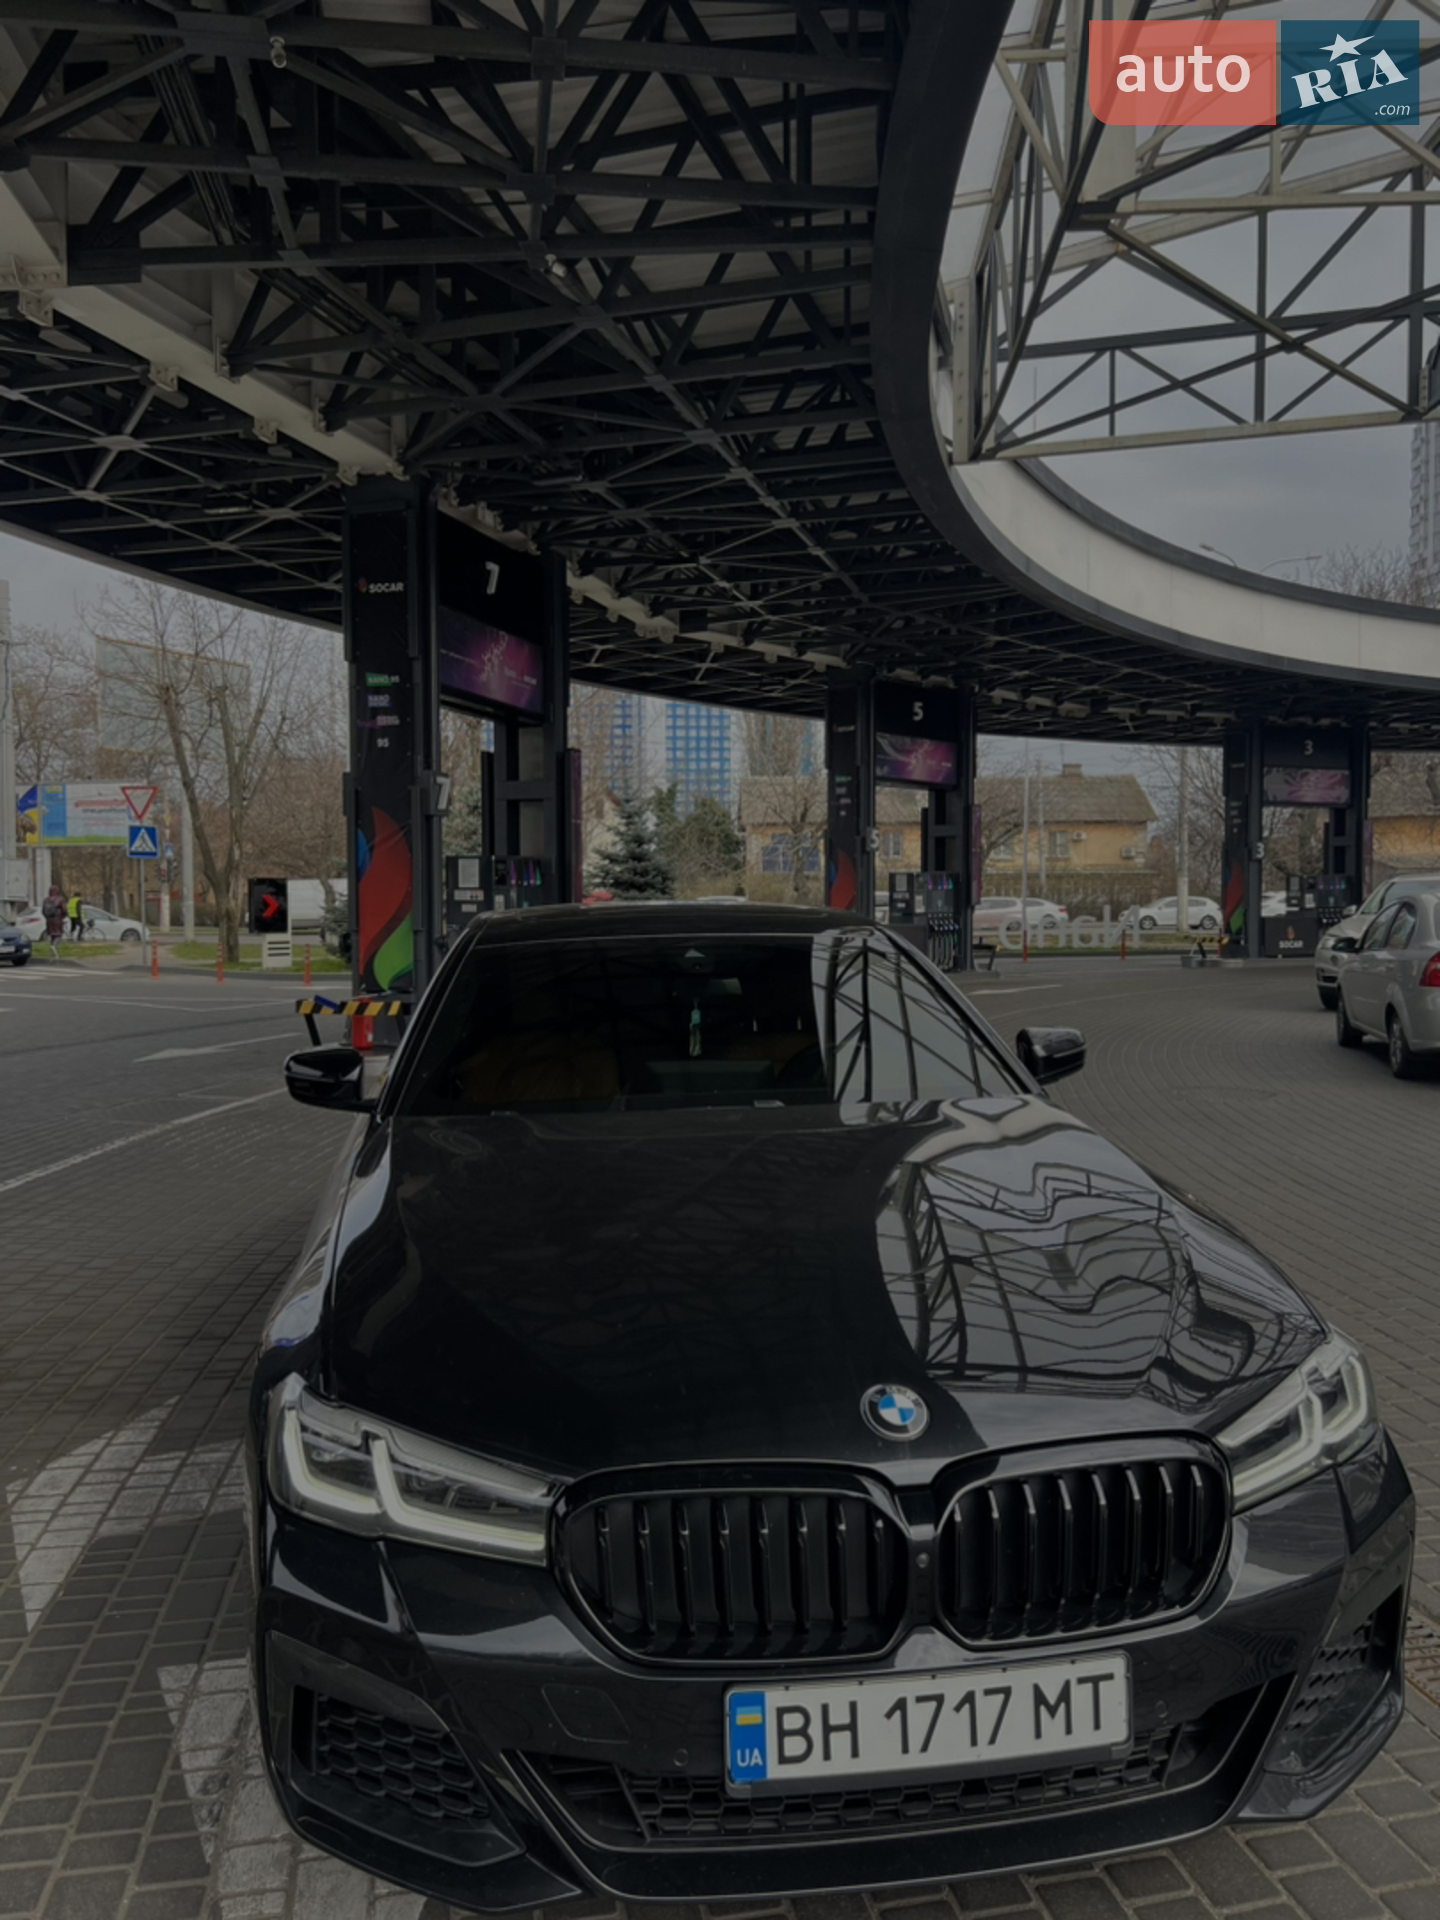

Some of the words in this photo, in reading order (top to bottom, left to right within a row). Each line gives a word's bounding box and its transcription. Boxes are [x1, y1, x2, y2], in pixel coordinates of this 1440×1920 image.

[485, 560, 500, 595] 7
[369, 581, 405, 594] SOCAR
[912, 702, 924, 721] 5
[376, 737, 390, 748] 95
[1303, 741, 1314, 756] 3
[435, 776, 450, 810] 7
[870, 829, 879, 849] 5
[1255, 843, 1265, 858] 3
[776, 1701, 859, 1765] BH
[884, 1687, 1012, 1755] 1717
[1032, 1673, 1115, 1740] MT
[736, 1749, 763, 1767] UA
